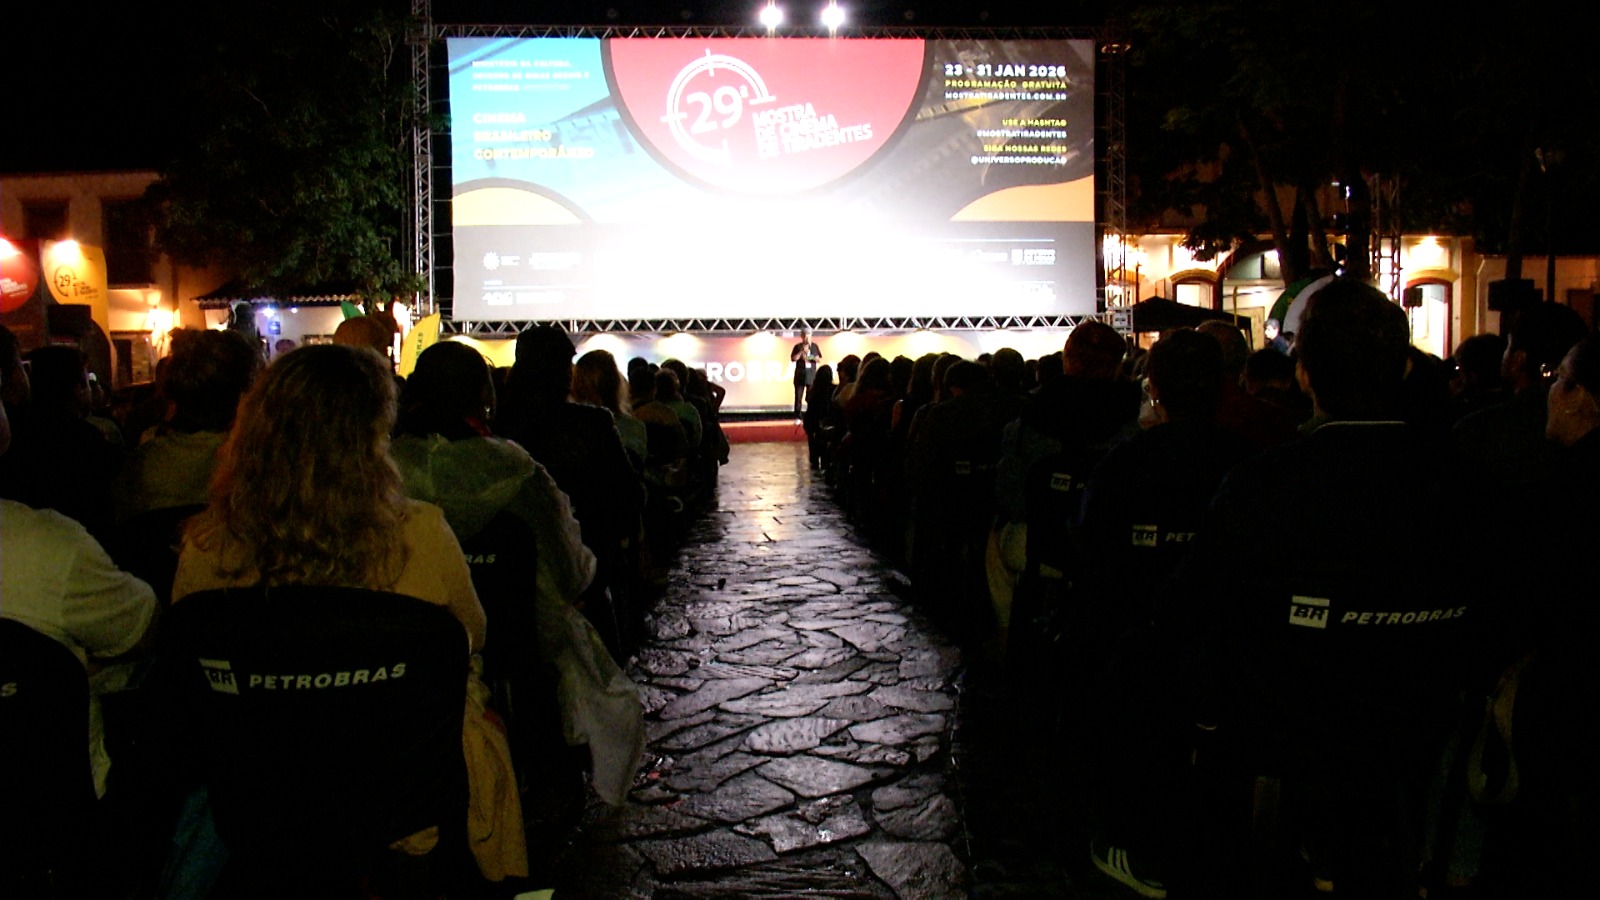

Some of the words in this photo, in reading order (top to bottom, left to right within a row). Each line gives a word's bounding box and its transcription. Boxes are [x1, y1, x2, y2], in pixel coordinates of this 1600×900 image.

[944, 64, 963, 77] 23
[976, 64, 992, 77] 31
[994, 64, 1026, 77] JAN
[1028, 65, 1066, 78] 2026
[944, 80, 1017, 89] PROGRAMAÇÃO
[1021, 81, 1067, 89] GRATUITA
[473, 112, 526, 124] CINEMA
[752, 102, 817, 126] MOSTRA
[779, 113, 838, 138] CINEMA
[1002, 119, 1018, 127] USE
[1019, 119, 1026, 127] A
[1027, 119, 1067, 127] HASHTAG
[781, 123, 873, 154] TIRADENTES
[983, 144, 1003, 152] SIGA
[1005, 145, 1038, 153] NOSSAS
[1040, 145, 1067, 153] REDES
[1340, 605, 1467, 625] PETROBRAS
[249, 662, 407, 690] PETROBRAS
